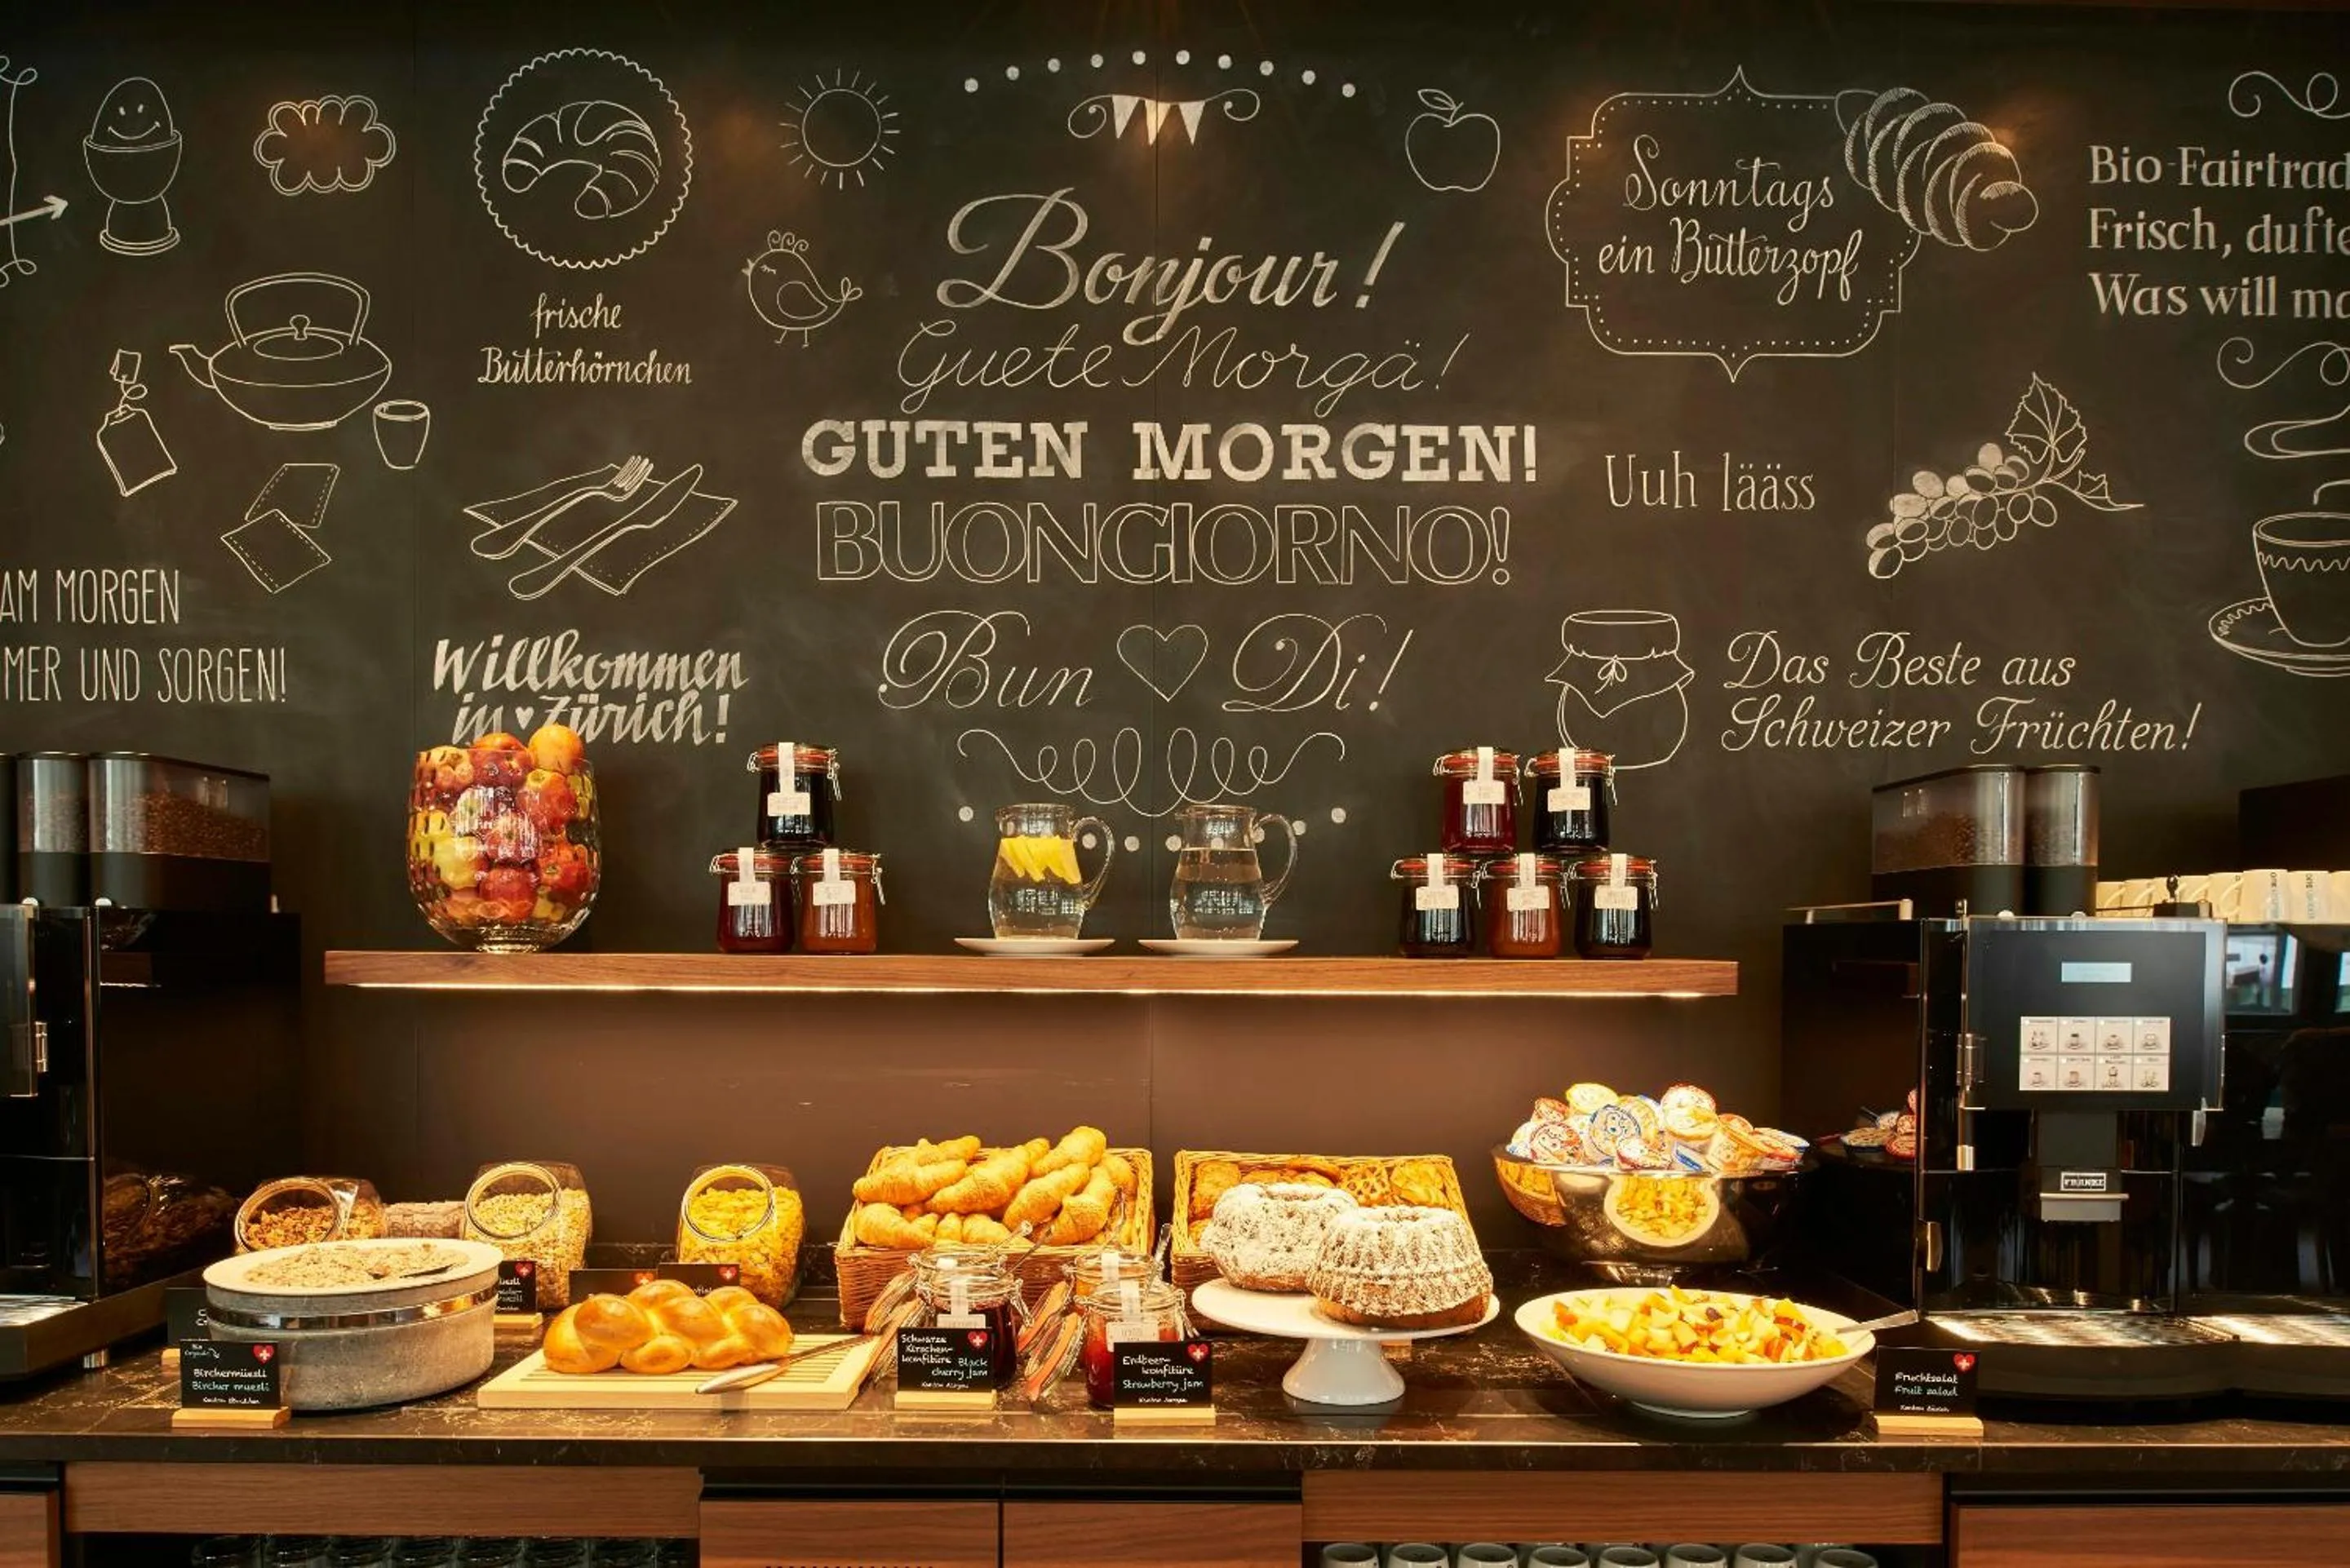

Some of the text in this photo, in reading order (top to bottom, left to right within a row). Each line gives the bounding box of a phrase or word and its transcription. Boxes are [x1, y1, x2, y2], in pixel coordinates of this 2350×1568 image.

[1622, 134, 1834, 233] Sonntags
[1598, 216, 1863, 306] ein Butterzopf
[2087, 206, 2232, 259] Frisch,
[530, 292, 623, 339] frische
[2087, 272, 2189, 317] Was
[2199, 275, 2279, 317] will
[477, 346, 693, 384] Butterhörnchen
[897, 319, 1470, 419] Guete Morgä!
[800, 419, 1538, 482] GUTEN MORGEN!
[1604, 450, 1816, 512] Uuh lääss
[816, 501, 1513, 586] BUONGIORNO!
[0, 569, 180, 625] AM MORGEN
[3, 646, 286, 703] MER UND SORGEN!
[432, 628, 750, 694] Willkommen
[877, 609, 1414, 712] Bun Di!
[1723, 630, 2077, 689] Das Beste aus
[451, 689, 730, 746] in Zürich!
[1720, 693, 2202, 755] Schweizer Früchten!
